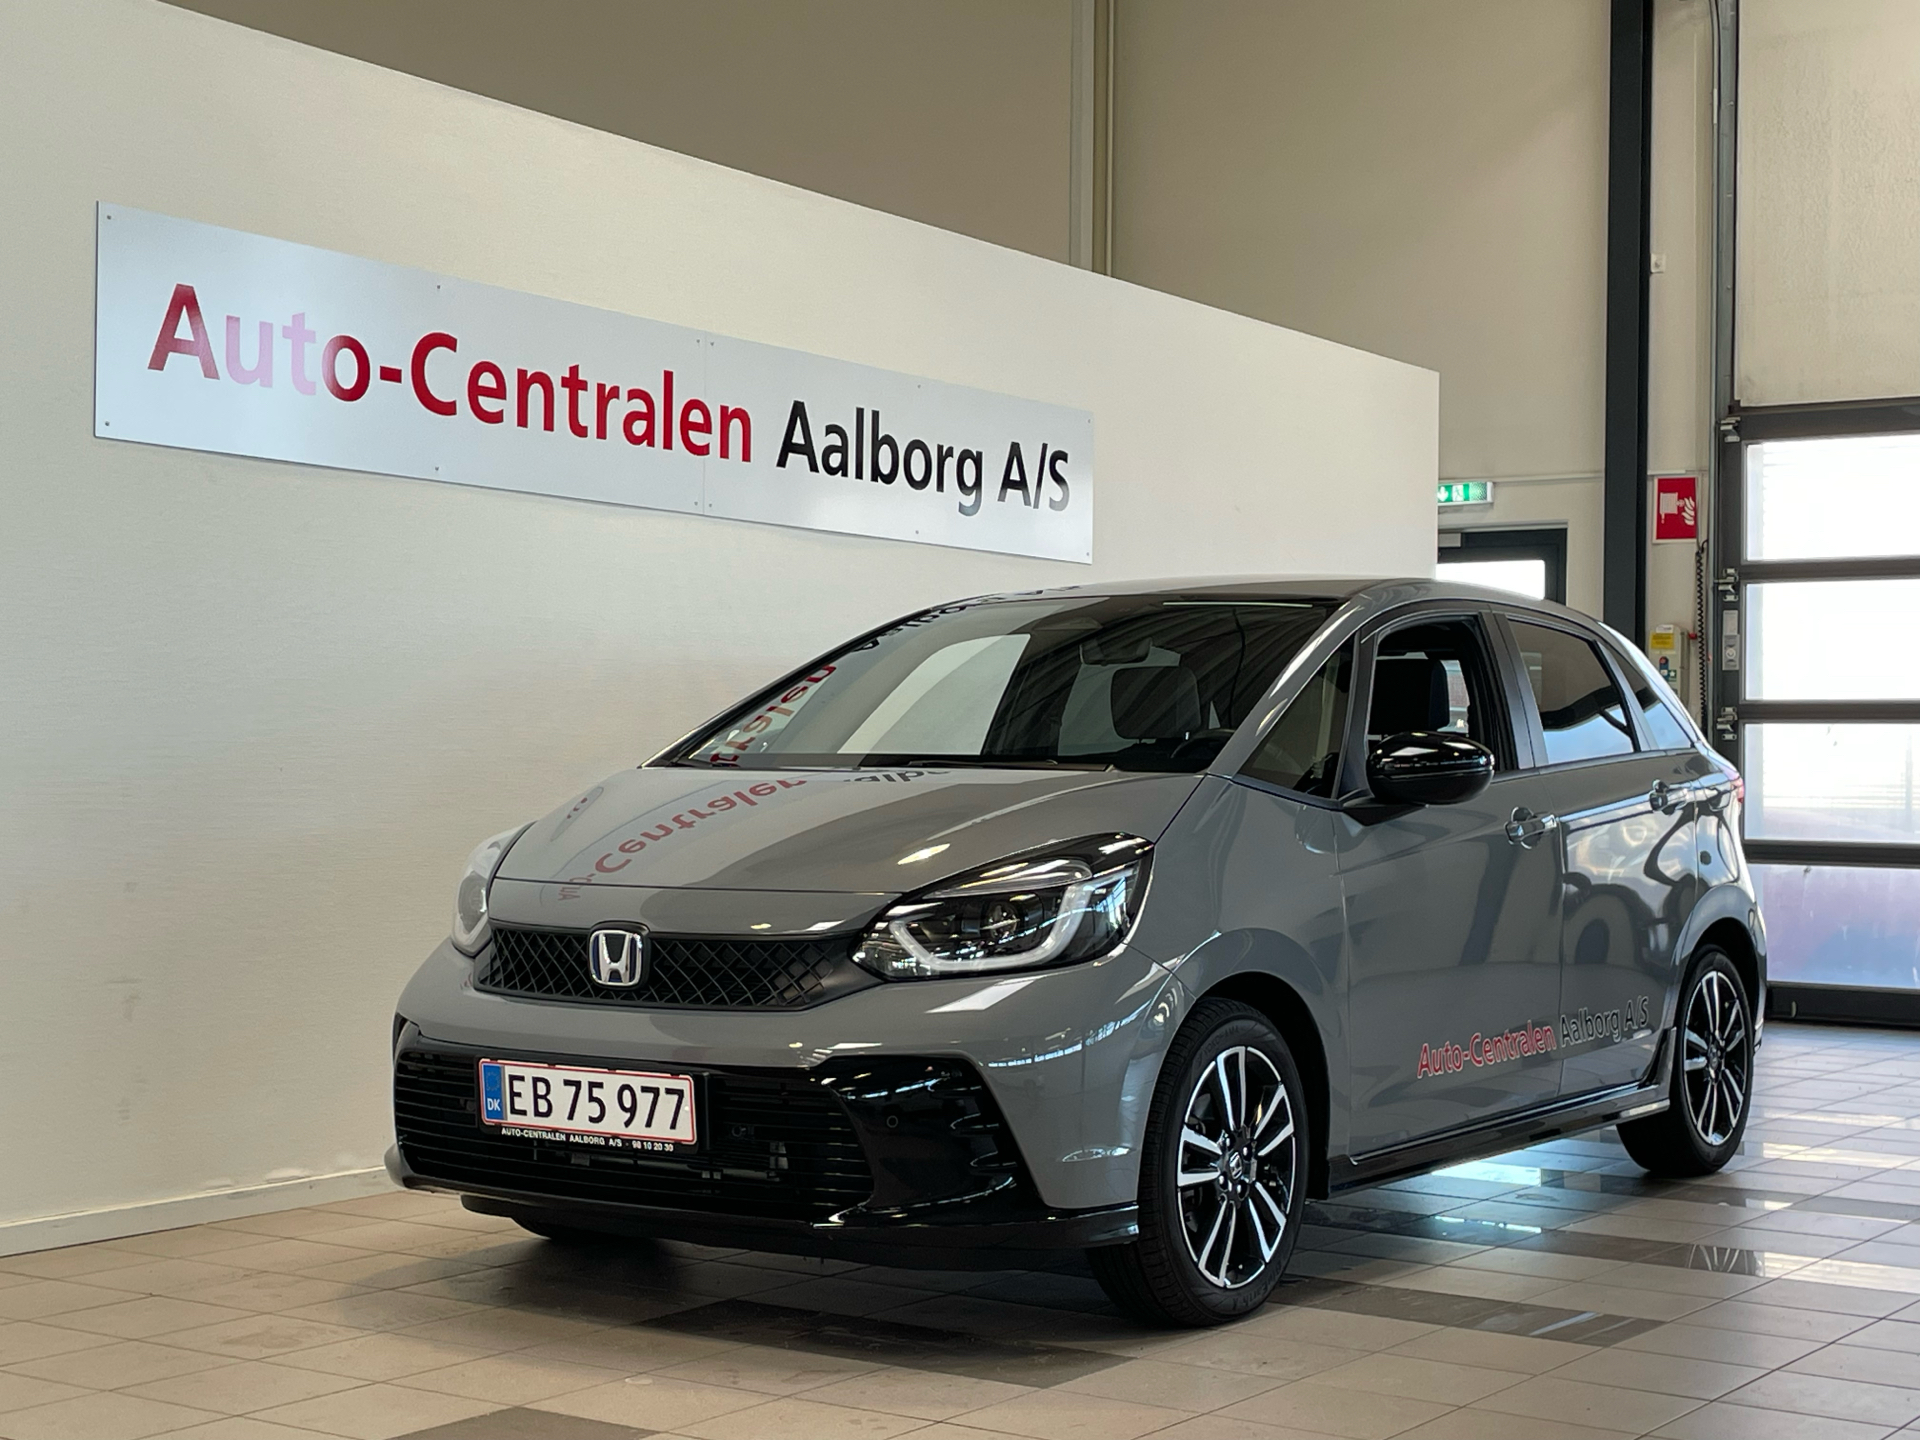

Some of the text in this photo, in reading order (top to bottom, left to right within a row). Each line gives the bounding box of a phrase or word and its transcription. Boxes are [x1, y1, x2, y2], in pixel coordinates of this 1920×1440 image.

[147, 283, 1070, 517] Auto-Centralen Aalborg A/S
[1416, 995, 1650, 1080] Auto-Centralen Aalborg A/S
[487, 1098, 501, 1111] DK
[508, 1074, 685, 1131] EB 75 977
[501, 1127, 567, 1141] AUTO-CENTRALEN
[569, 1135, 606, 1146] AALBORG
[608, 1138, 623, 1147] A/S
[643, 1142, 652, 1150] 10
[653, 1142, 663, 1151] 20
[664, 1143, 674, 1152] 30
